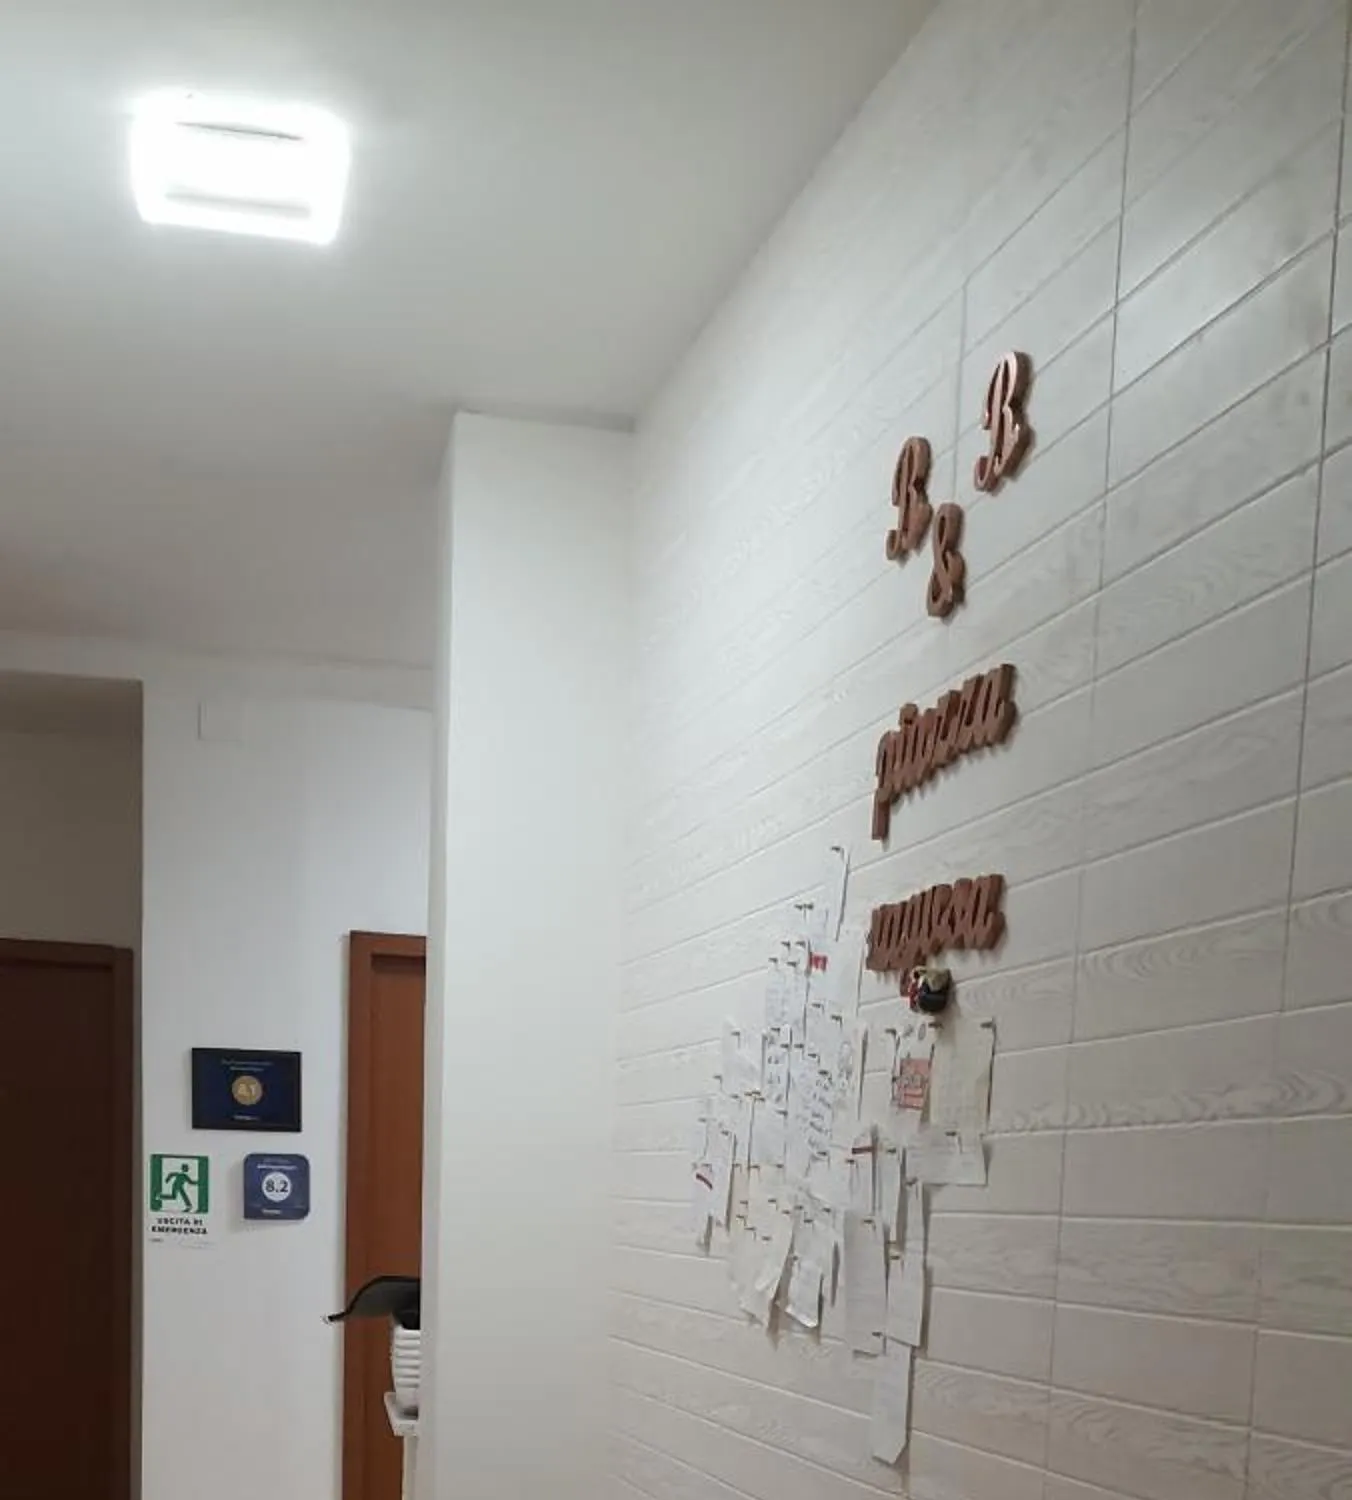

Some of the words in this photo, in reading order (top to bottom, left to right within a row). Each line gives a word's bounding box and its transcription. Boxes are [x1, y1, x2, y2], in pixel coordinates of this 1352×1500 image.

[885, 436, 933, 562] B
[926, 502, 967, 619] &
[972, 350, 1035, 494] B
[265, 1178, 289, 1193] 8.2
[157, 1217, 191, 1226] USCITA
[151, 1226, 208, 1235] EMERGENZA
